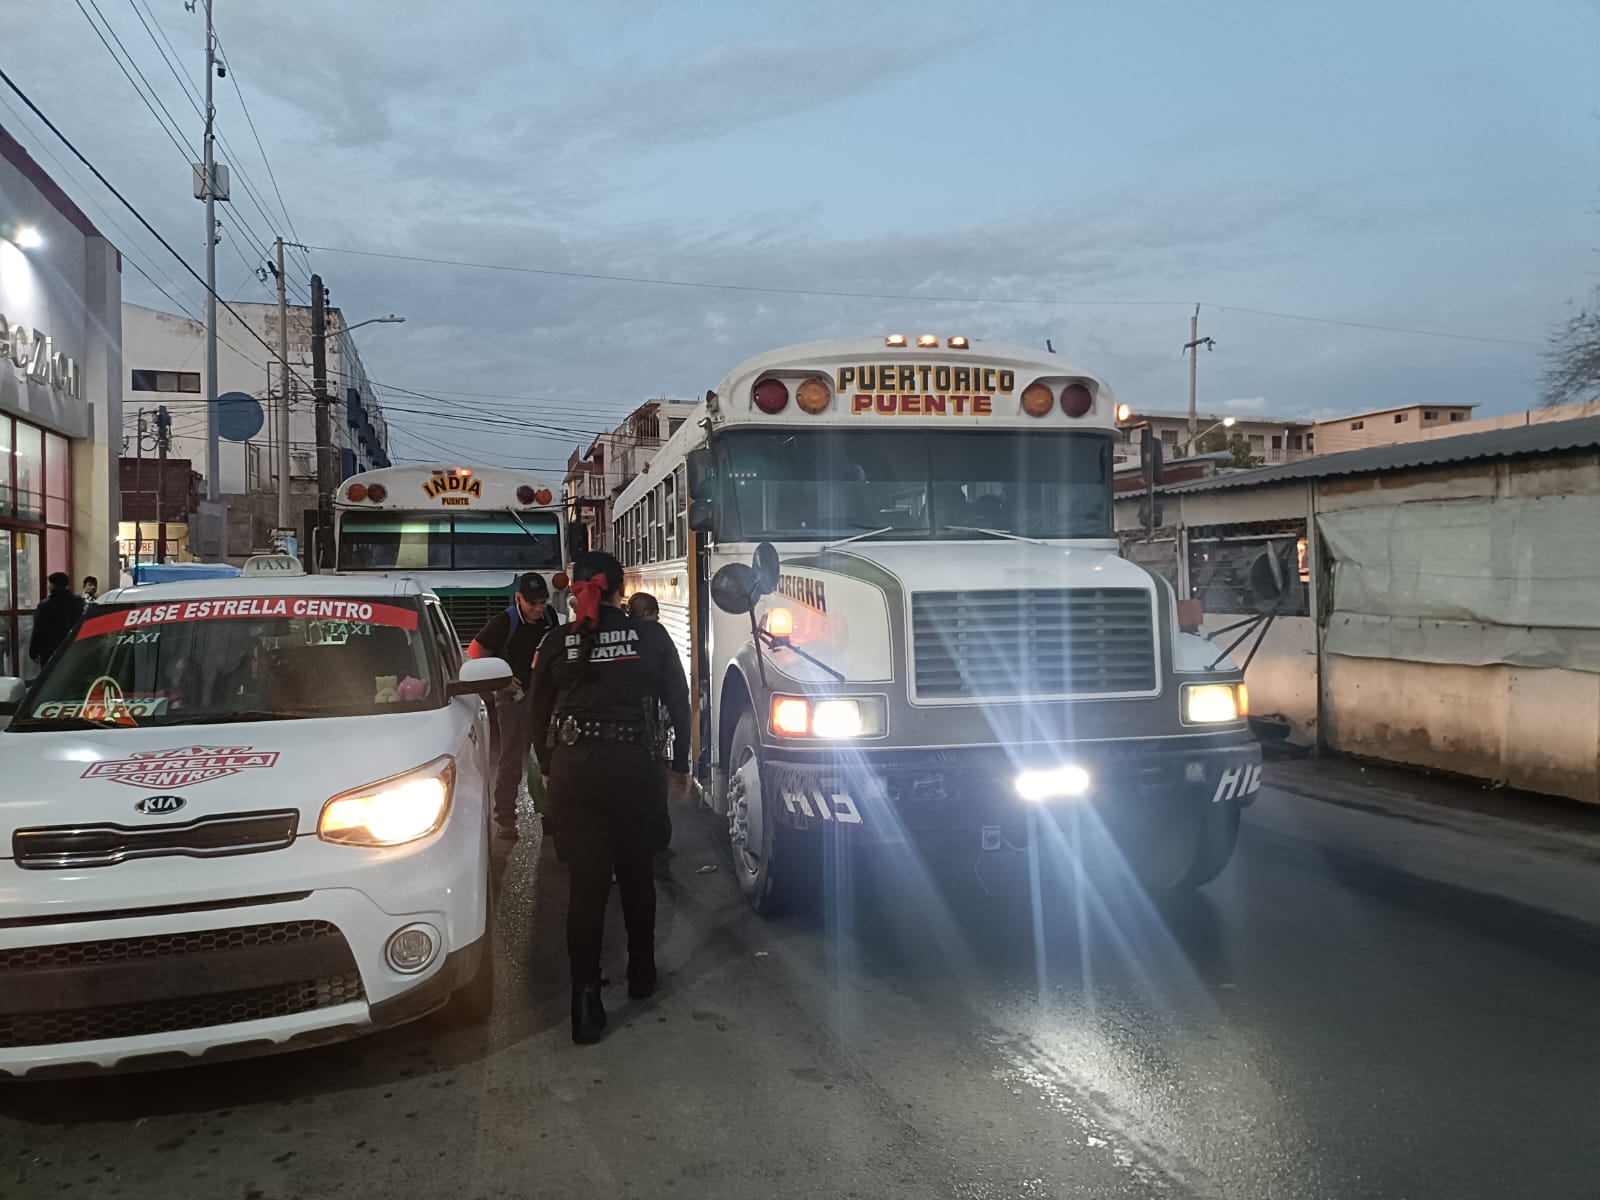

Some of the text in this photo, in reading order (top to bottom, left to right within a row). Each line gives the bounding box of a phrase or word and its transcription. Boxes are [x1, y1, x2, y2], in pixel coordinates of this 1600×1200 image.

[852, 394, 992, 415] PUENTE
[422, 475, 482, 499] INDIA
[441, 497, 469, 506] PUENTE
[255, 557, 292, 570] TAXI
[123, 599, 373, 627] BASE ESTRELLA CENTRO
[327, 622, 371, 635] TAXI
[116, 632, 161, 645] TAXI
[564, 629, 640, 647] GRDIA
[567, 644, 638, 660] ETATAL
[102, 755, 265, 774] ESTRELLA
[129, 768, 223, 786] CENTRO
[143, 796, 178, 810] KIA
